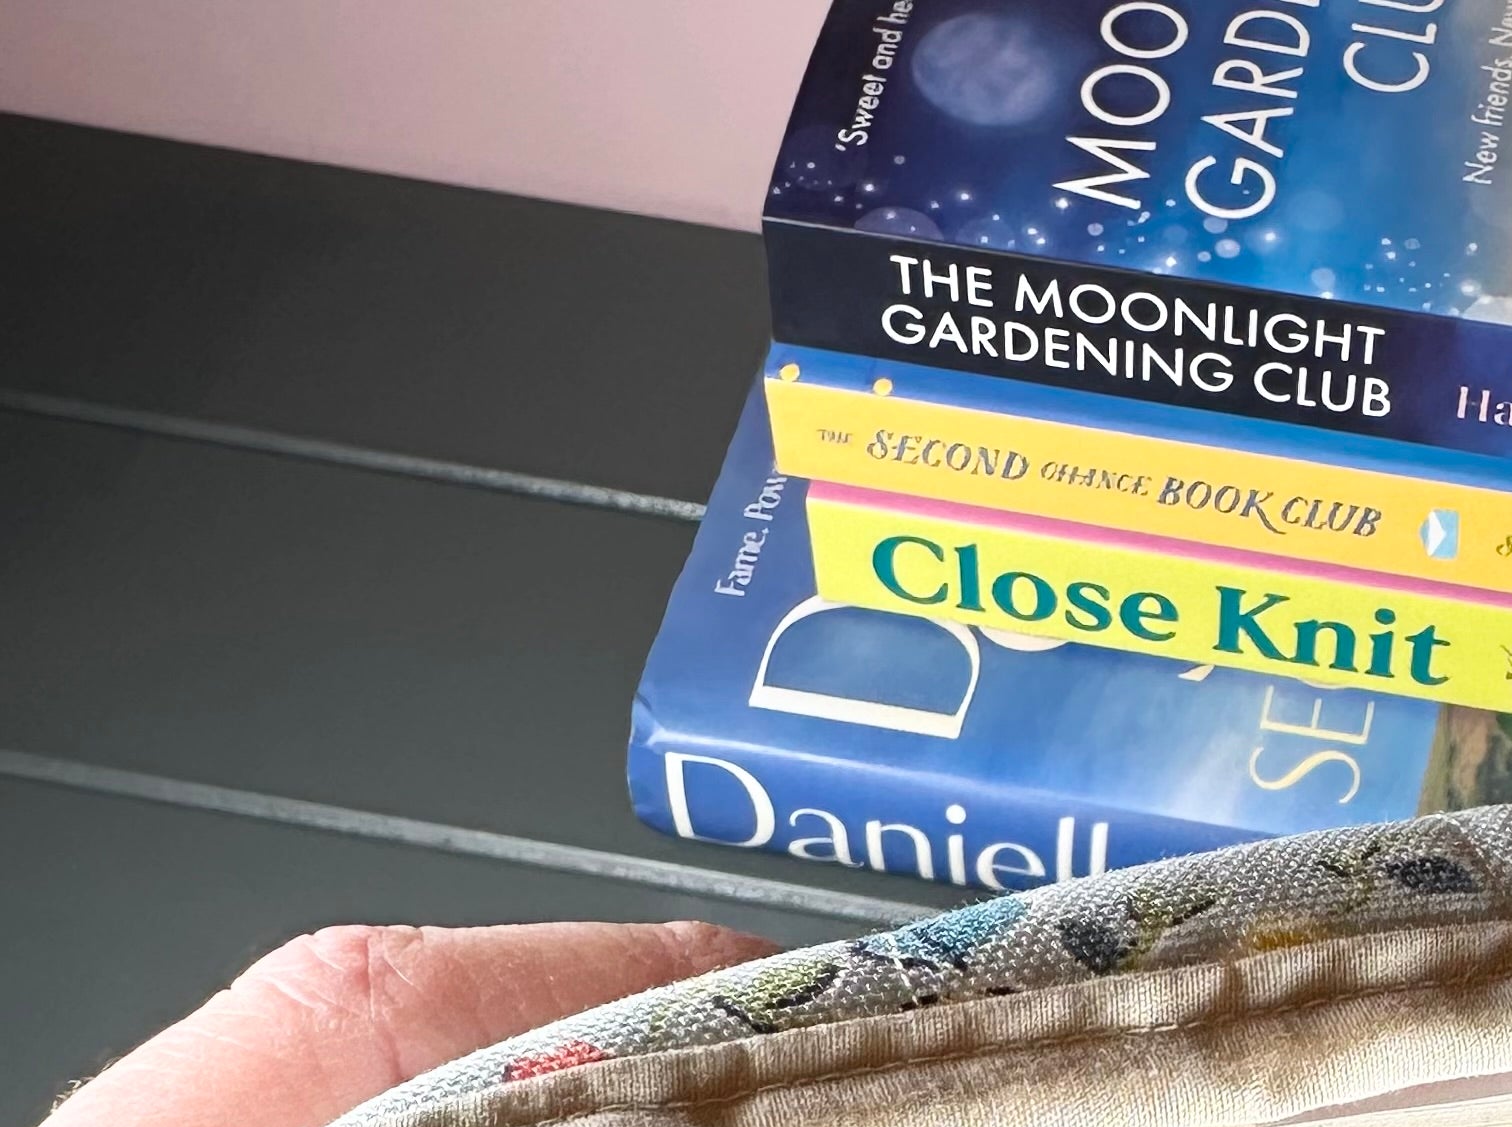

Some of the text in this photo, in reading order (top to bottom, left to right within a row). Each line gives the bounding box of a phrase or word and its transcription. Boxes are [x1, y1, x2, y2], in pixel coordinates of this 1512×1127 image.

[872, 27, 903, 69] and
[1185, 0, 1321, 219] GARD
[1462, 131, 1500, 185] New
[881, 303, 1392, 418] GARDENING CLUB
[889, 254, 1386, 365] THE MOONLIGHT
[866, 429, 1030, 481] SECOND
[1040, 461, 1153, 497] CHANCE
[1157, 475, 1288, 536] BOOK
[1280, 496, 1383, 537] CLUB
[872, 535, 1180, 642] Close
[1213, 584, 1452, 686] Knit
